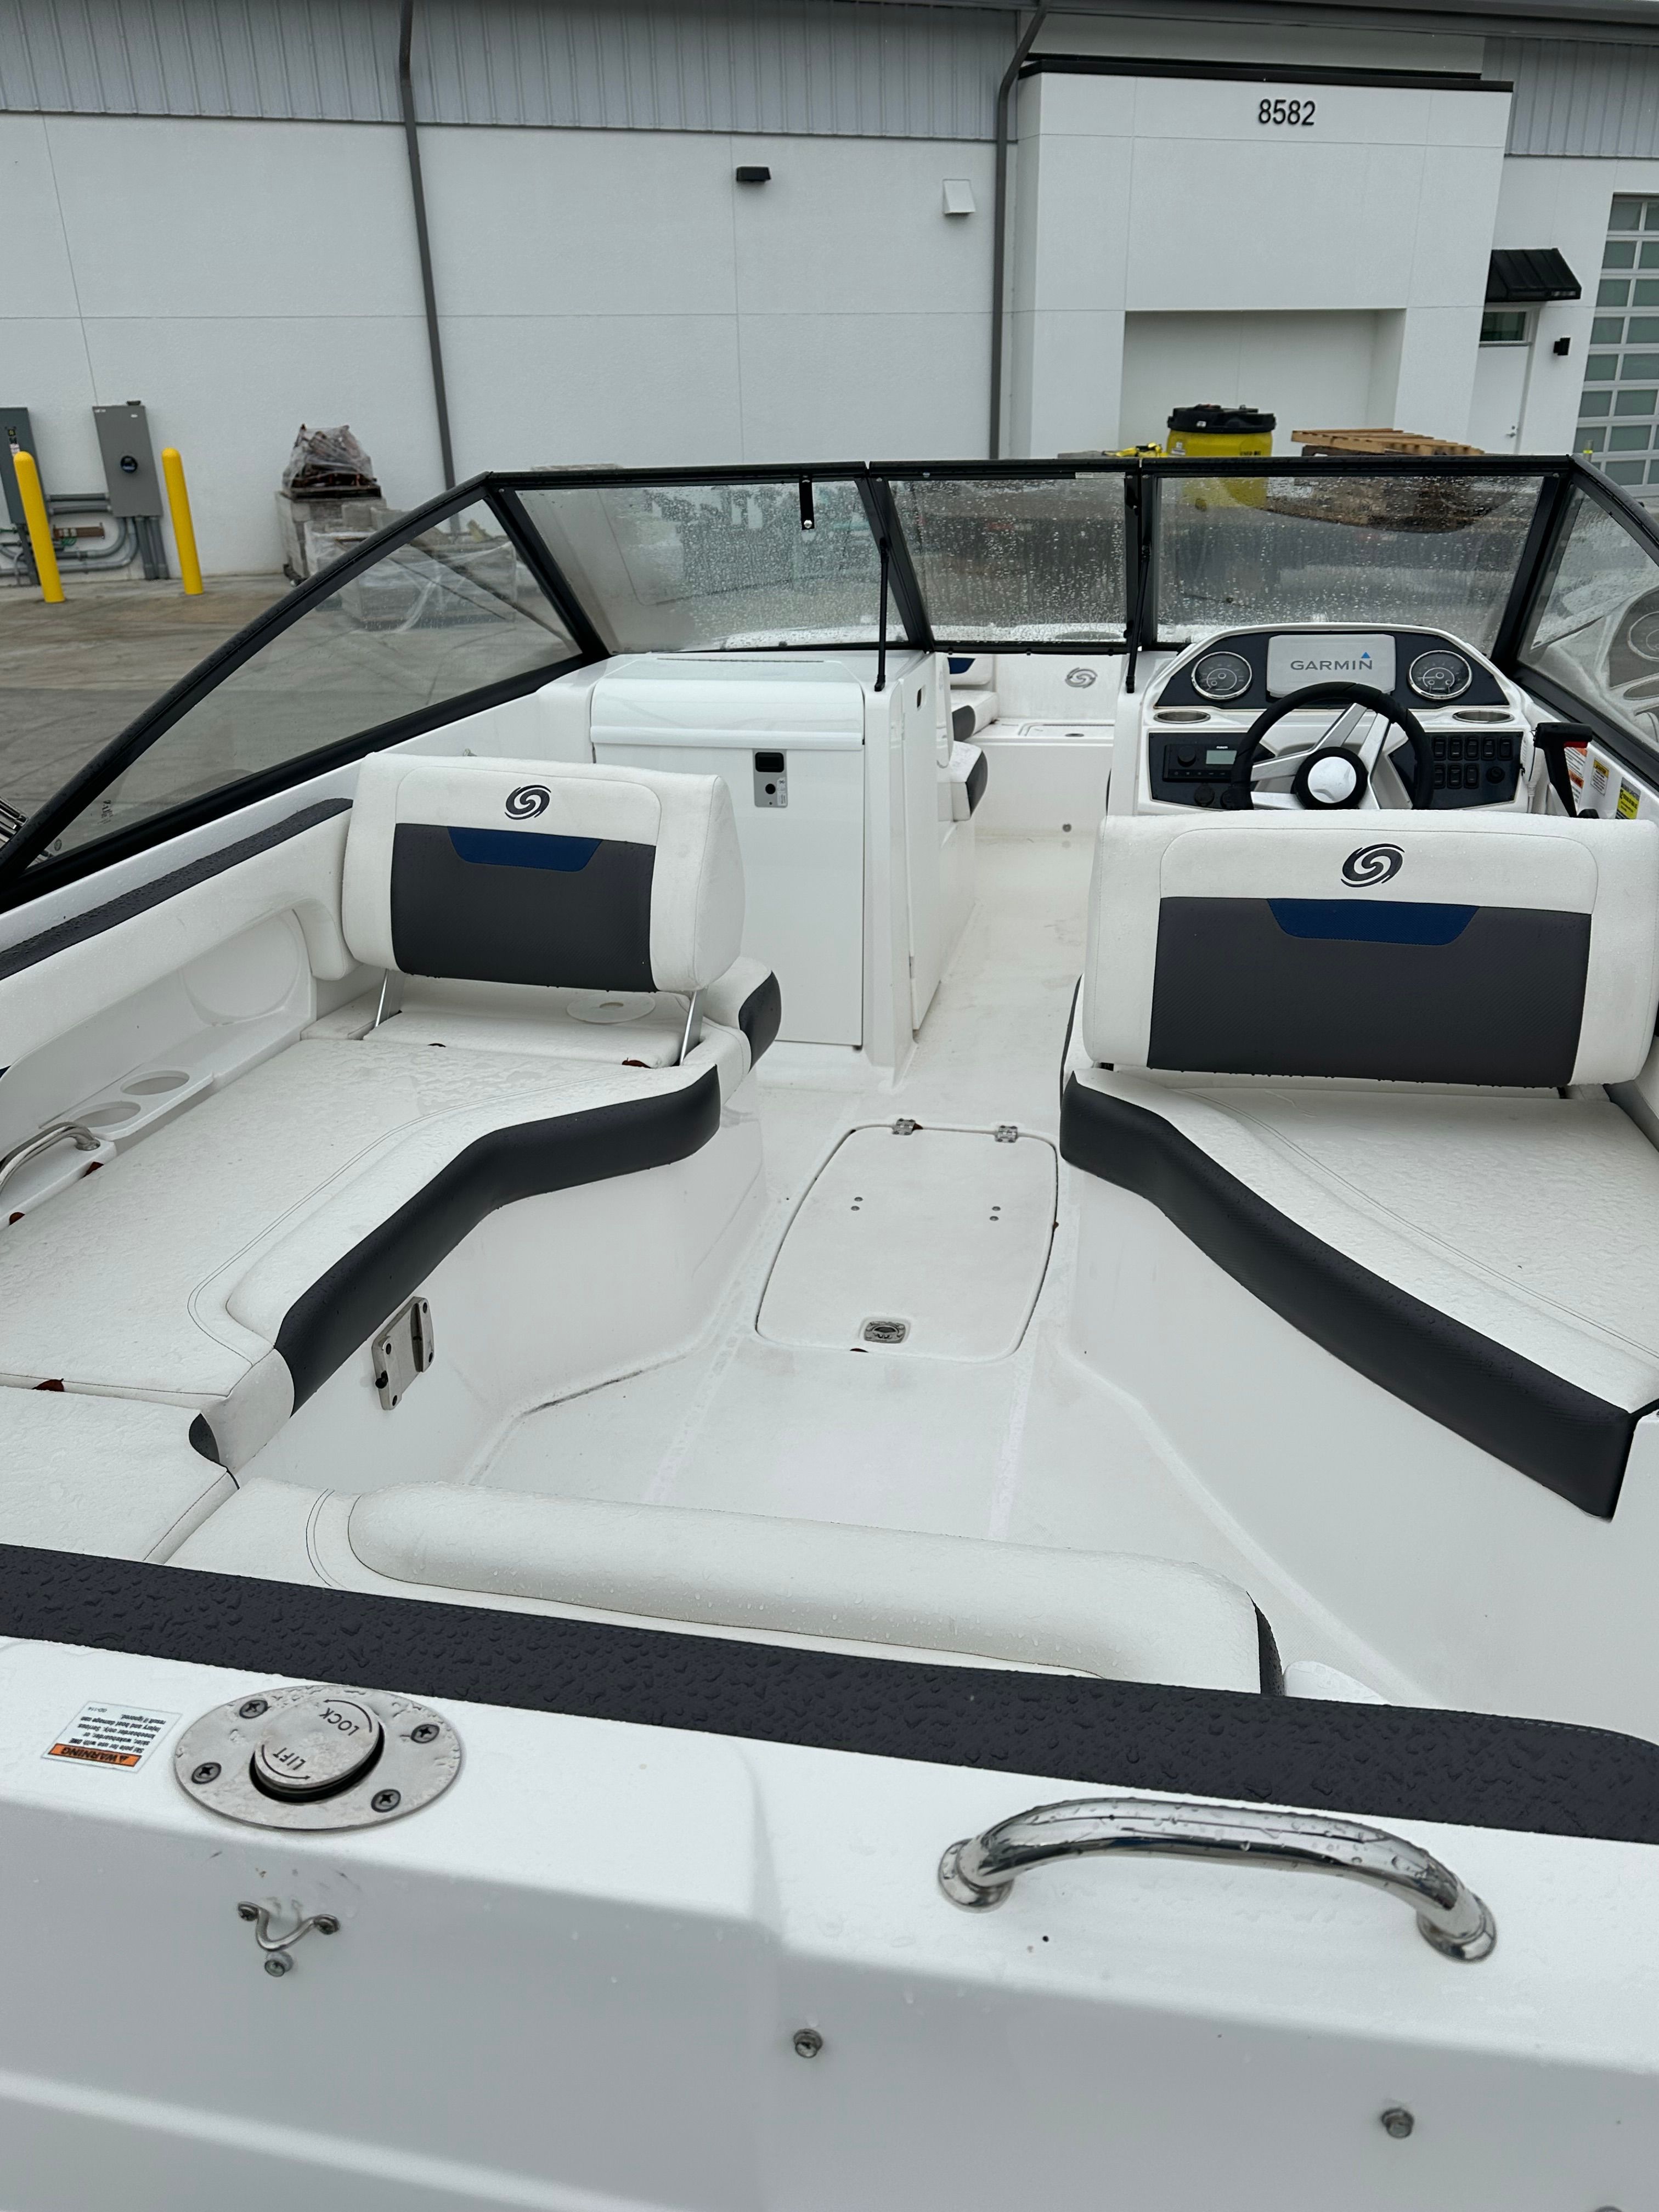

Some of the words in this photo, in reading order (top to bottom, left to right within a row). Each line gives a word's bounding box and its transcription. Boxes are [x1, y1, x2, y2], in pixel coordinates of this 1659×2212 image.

[1259, 98, 1316, 126] 8582
[1290, 660, 1372, 670] GARMIN
[77, 1724, 101, 1732] Serious
[92, 1718, 115, 1726] damage
[319, 1707, 360, 1736] LOCK
[61, 1748, 117, 1762] WARNING
[273, 1747, 306, 1770] LIFT
